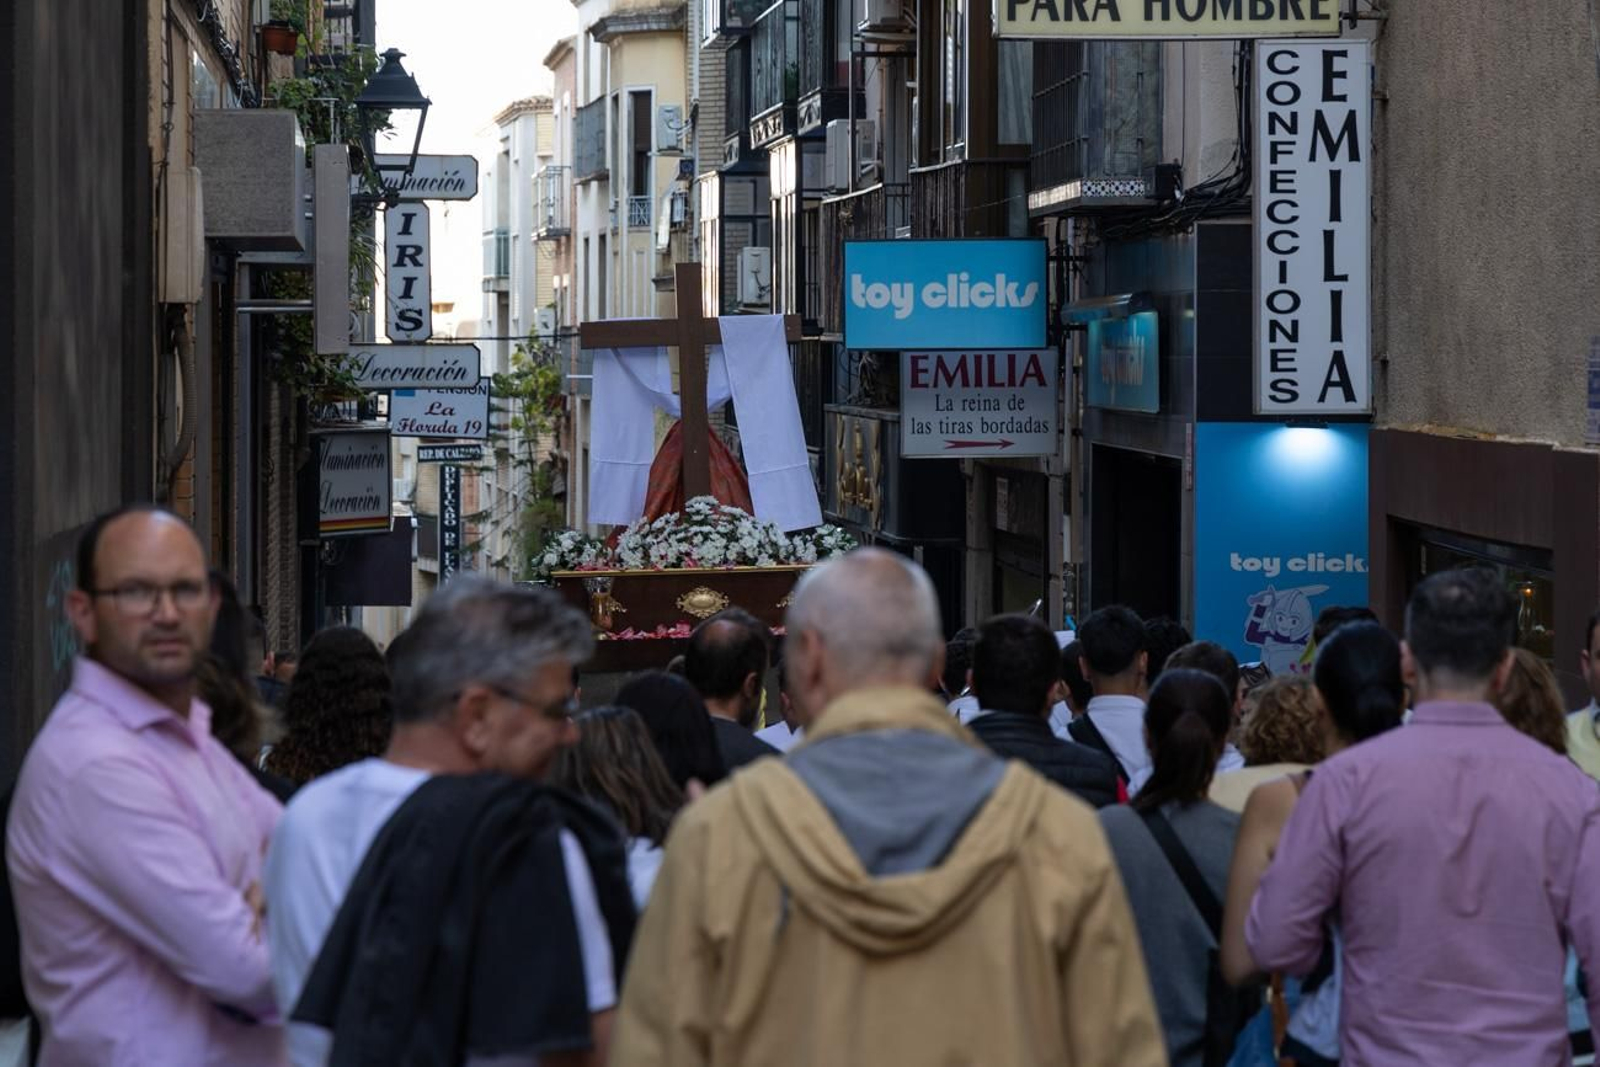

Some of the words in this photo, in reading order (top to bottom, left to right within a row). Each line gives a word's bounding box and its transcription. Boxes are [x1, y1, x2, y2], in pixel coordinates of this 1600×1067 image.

[1006, 0, 1121, 22] PARA
[1143, 0, 1331, 22] HOMBRE
[1266, 49, 1302, 404] CONFECCIONES
[1308, 49, 1361, 403] EMILIA
[392, 212, 424, 332] IRIS
[851, 273, 914, 319] toy
[921, 272, 1039, 309] clicks
[353, 351, 468, 381] Decoración
[910, 353, 1047, 388] EMILIA
[424, 401, 455, 416] La
[935, 394, 953, 411] La
[962, 394, 1001, 411] reina
[1008, 393, 1025, 411] de
[464, 420, 482, 434] 19
[910, 417, 931, 434] las
[939, 417, 973, 434] tiras
[981, 416, 1049, 434] bordadas
[1230, 552, 1281, 578] toy
[1286, 552, 1368, 572] click
